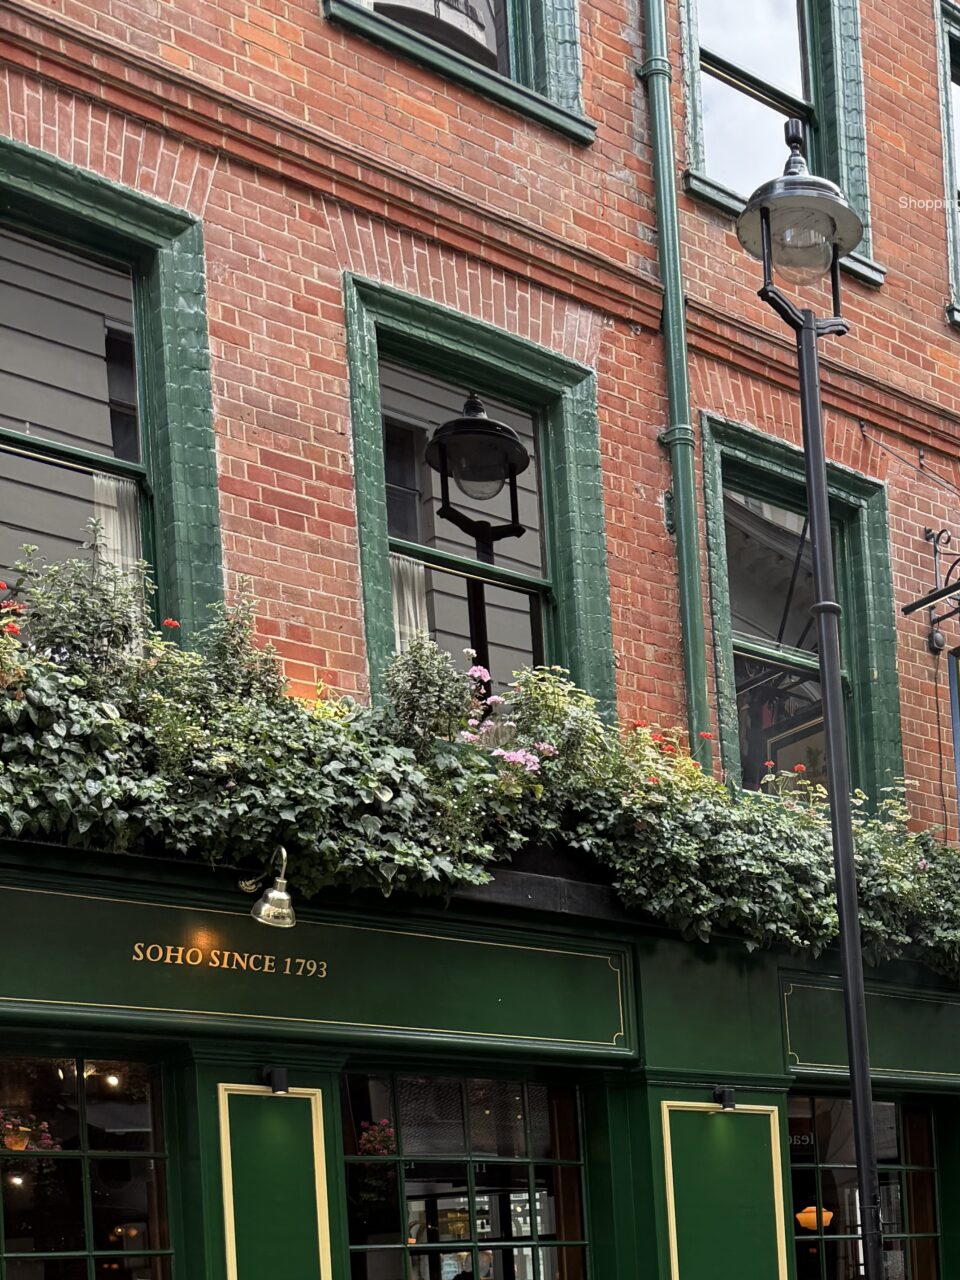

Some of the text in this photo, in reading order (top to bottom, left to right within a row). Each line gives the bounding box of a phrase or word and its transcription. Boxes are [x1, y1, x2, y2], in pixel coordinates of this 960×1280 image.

[132, 942, 328, 979] SOHO SINCE 1793
